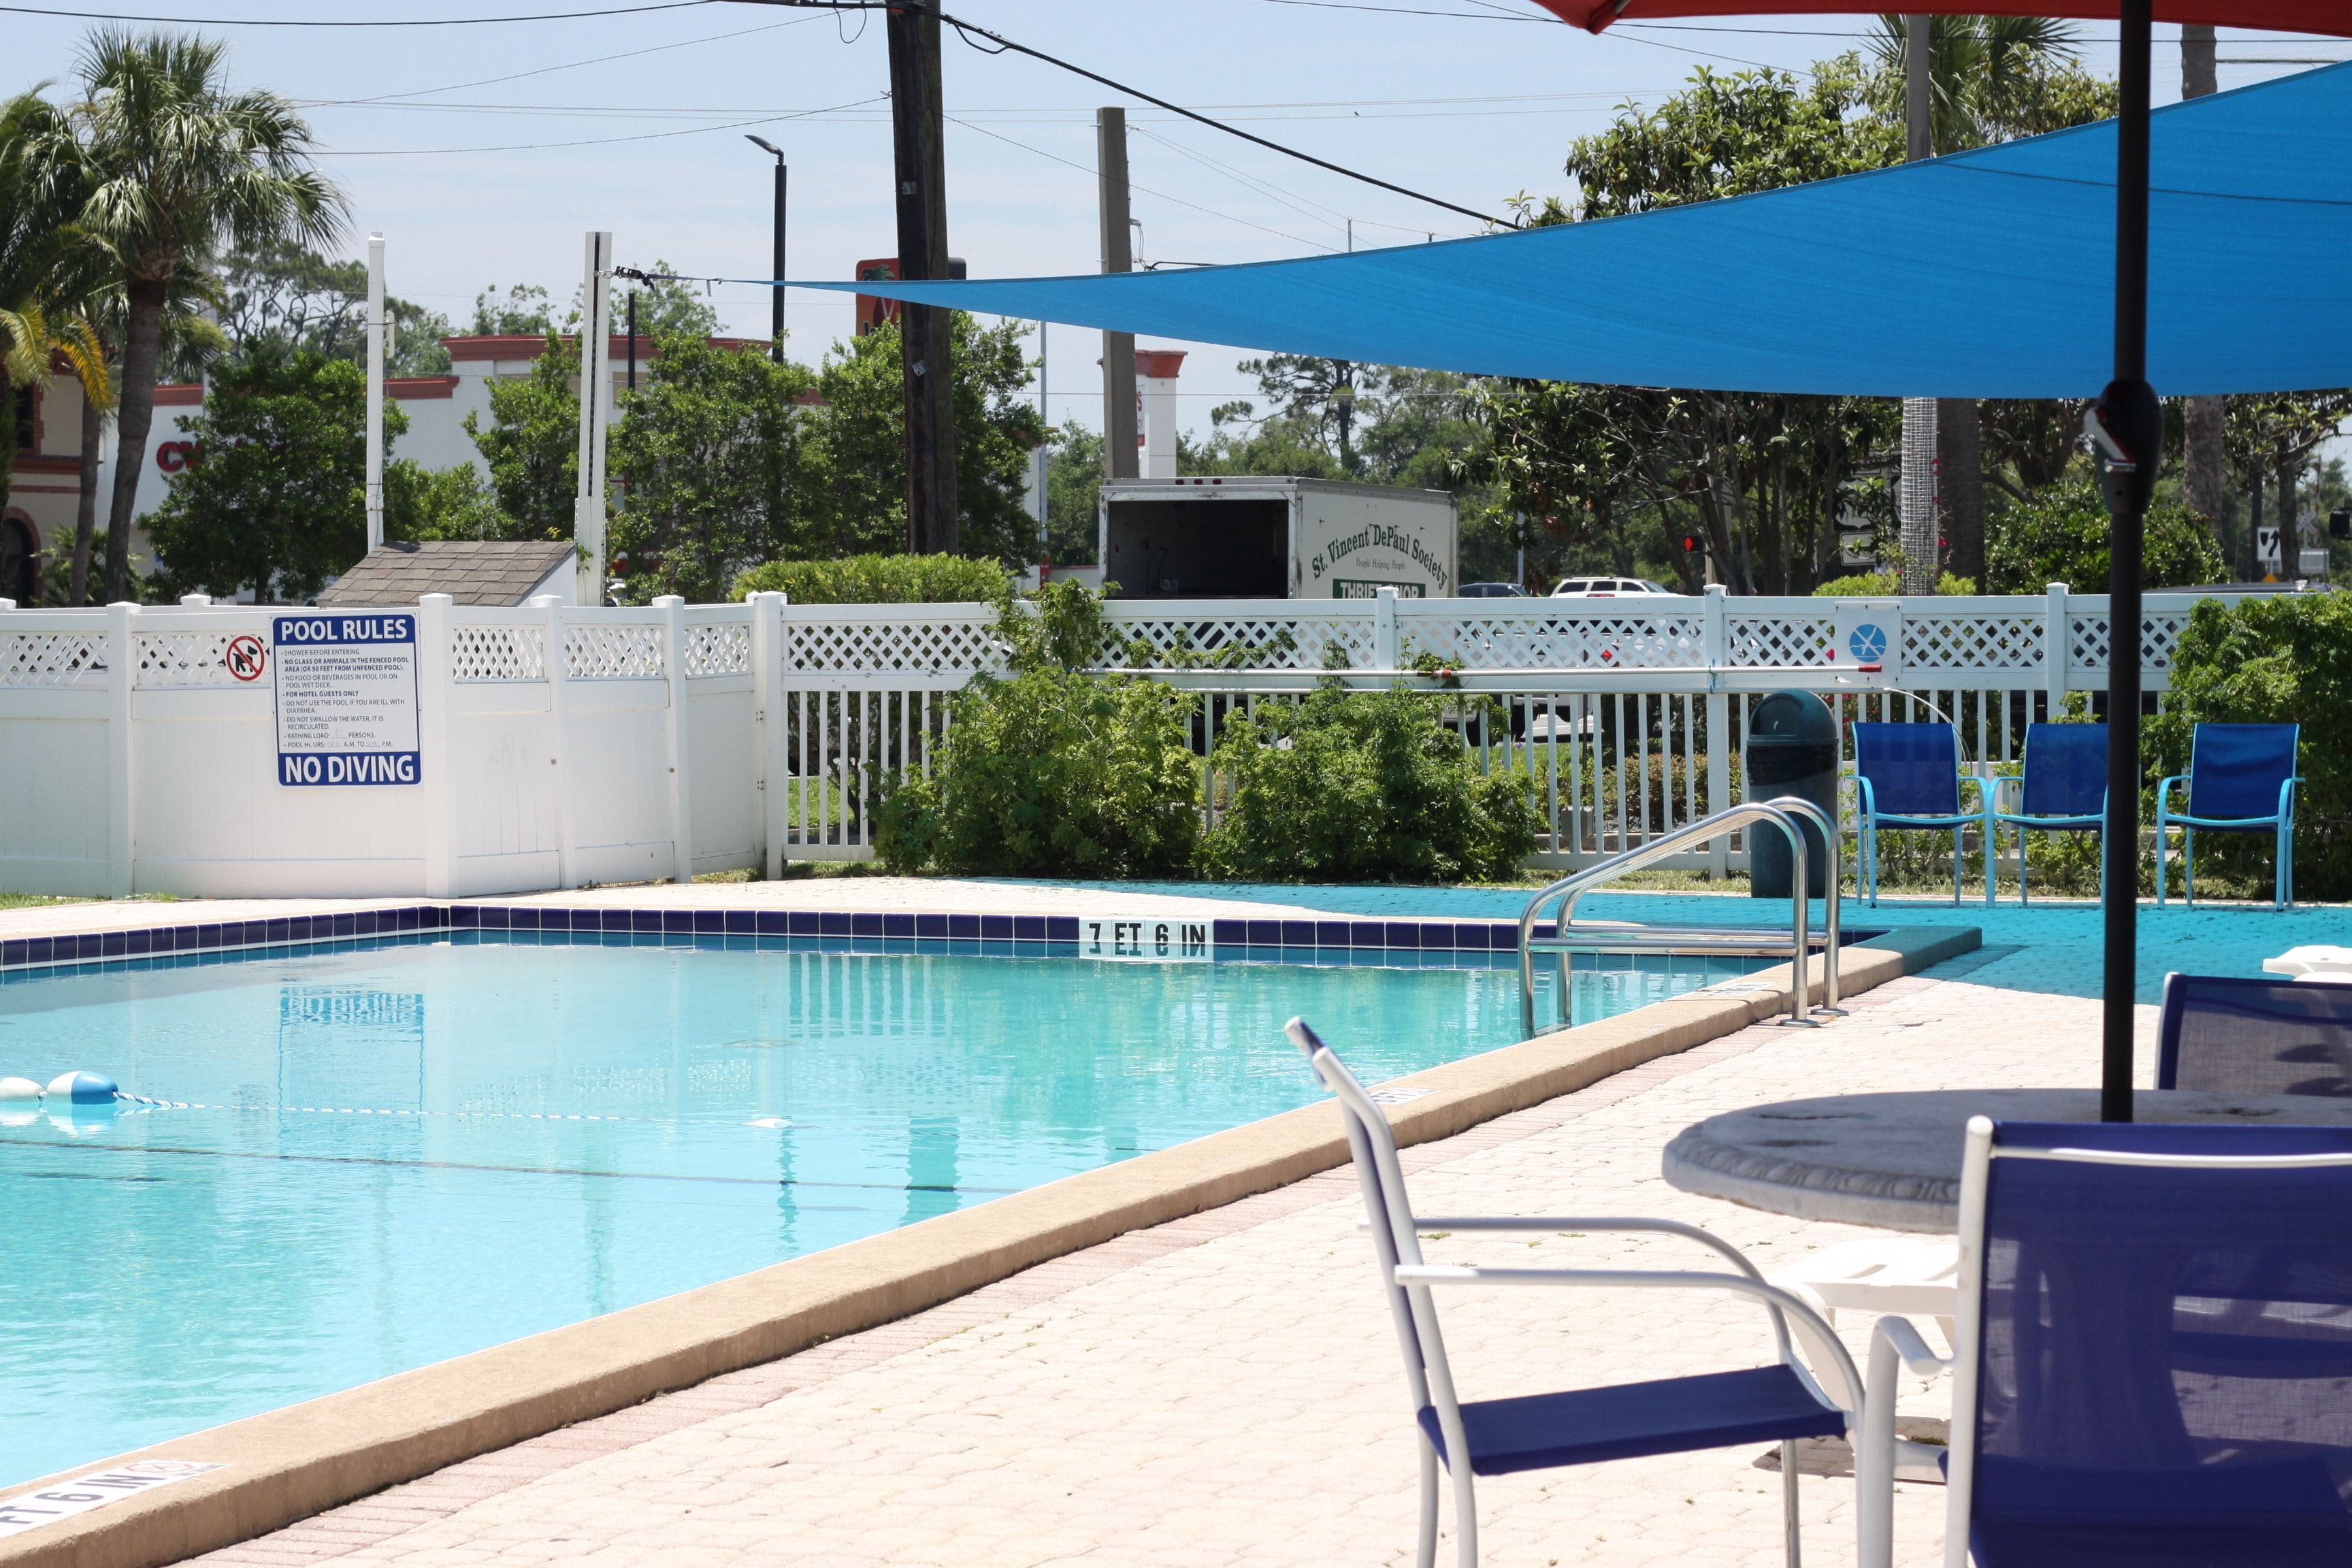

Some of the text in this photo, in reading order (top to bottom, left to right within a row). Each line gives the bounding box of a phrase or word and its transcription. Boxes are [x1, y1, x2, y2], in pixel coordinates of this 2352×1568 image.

[1312, 524, 1448, 589] St. Vincent DePaul Society
[1389, 585, 1419, 598] HOP
[282, 619, 407, 641] POOL RULES
[285, 755, 414, 783] NO DIVING
[1089, 923, 1101, 941] 7
[1156, 924, 1169, 943] 6
[1181, 924, 1205, 943] IN
[35, 1492, 103, 1502] 6
[74, 1474, 167, 1489] IN
